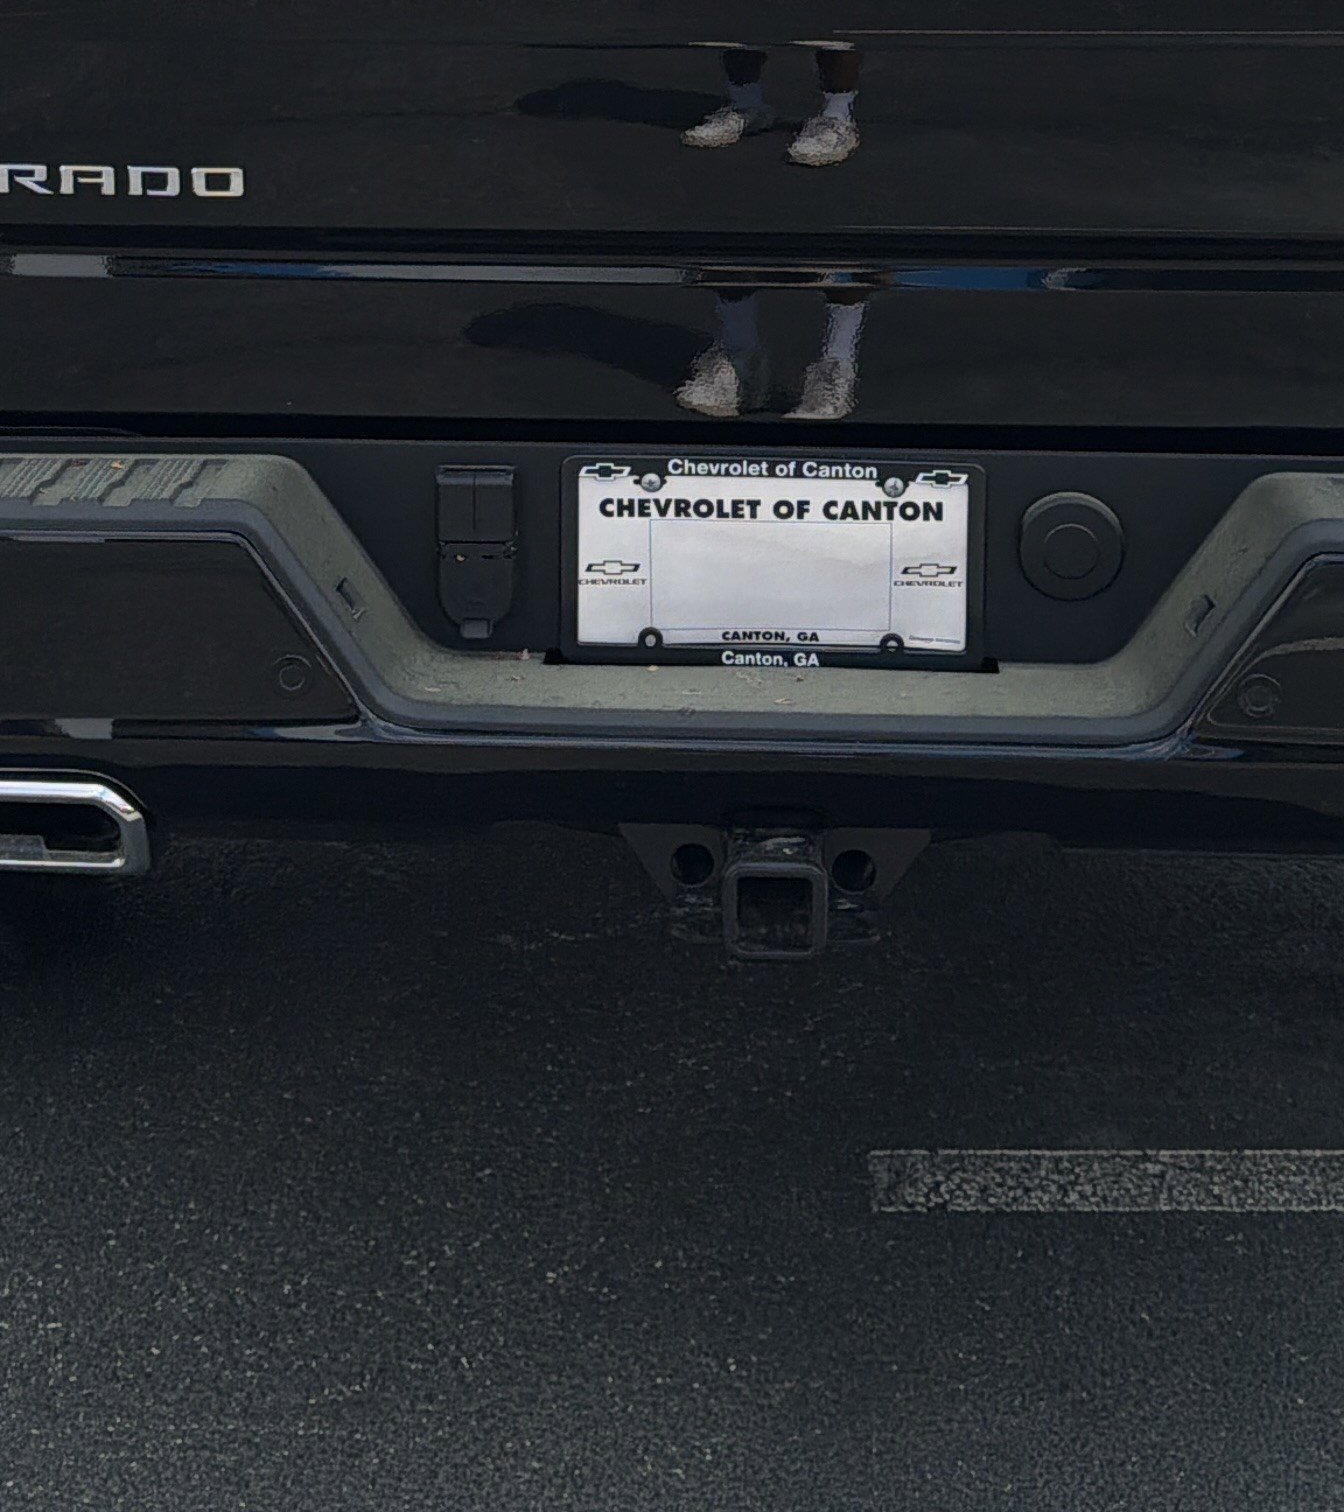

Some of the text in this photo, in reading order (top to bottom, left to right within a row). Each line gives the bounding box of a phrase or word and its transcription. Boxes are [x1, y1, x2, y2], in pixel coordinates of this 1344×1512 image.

[667, 458, 878, 481] Chevrolet of Canton
[599, 498, 945, 522] CHEVROLET OF CANTON
[578, 578, 647, 586] CHEVROLET
[893, 580, 964, 588] CHEVROLET
[721, 630, 820, 643] CANTON, GA
[721, 650, 820, 667] Canton, GA
